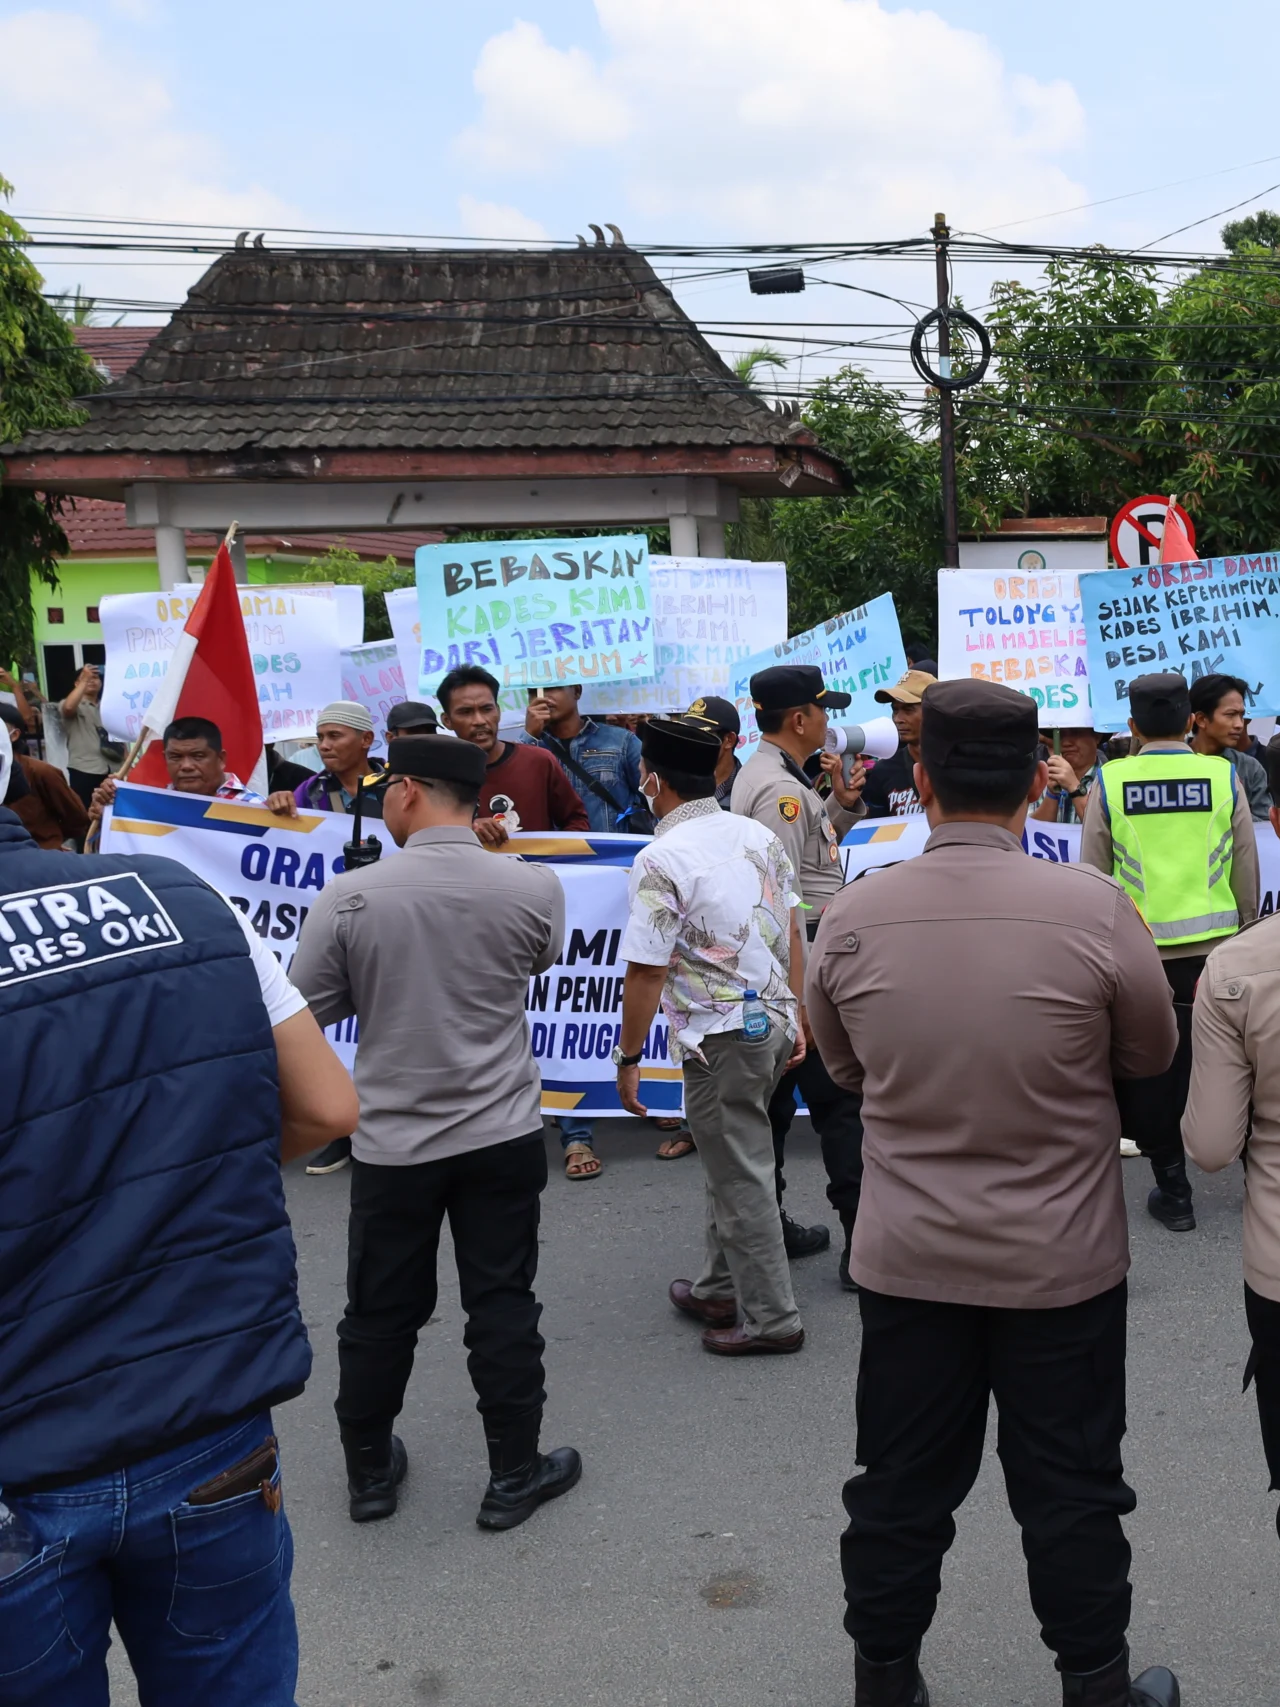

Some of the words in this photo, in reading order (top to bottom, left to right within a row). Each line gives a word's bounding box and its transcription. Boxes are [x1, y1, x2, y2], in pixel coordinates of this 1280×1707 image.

[443, 548, 644, 597] BEBASKAN
[1148, 559, 1214, 590] ORASI
[1224, 554, 1279, 578] DAMAI
[994, 576, 1062, 600] ORASI
[156, 598, 197, 622] ORA
[242, 596, 296, 616] AMAI
[446, 593, 558, 639] KADES
[568, 580, 648, 617] KAMI
[655, 593, 758, 617] IBRAHIM
[958, 603, 1056, 628] TOLONG
[1098, 594, 1161, 620] SEJAK
[126, 626, 177, 652] PAK
[828, 626, 867, 655] MAU
[966, 630, 996, 652] LIA
[1002, 627, 1087, 650] MAJELIS
[1100, 618, 1161, 642] KADES
[421, 632, 501, 675] DARI
[510, 616, 651, 660] JERATAN
[655, 644, 700, 666] IDAK
[1106, 641, 1169, 670] DESA
[1178, 624, 1242, 656] KAMI
[360, 665, 406, 696] LOV
[504, 649, 622, 688] HUKUM
[970, 654, 1088, 682] BEBASKA
[1126, 783, 1209, 810] POLISI
[100, 912, 170, 946] OKI
[531, 1022, 556, 1059] DI
